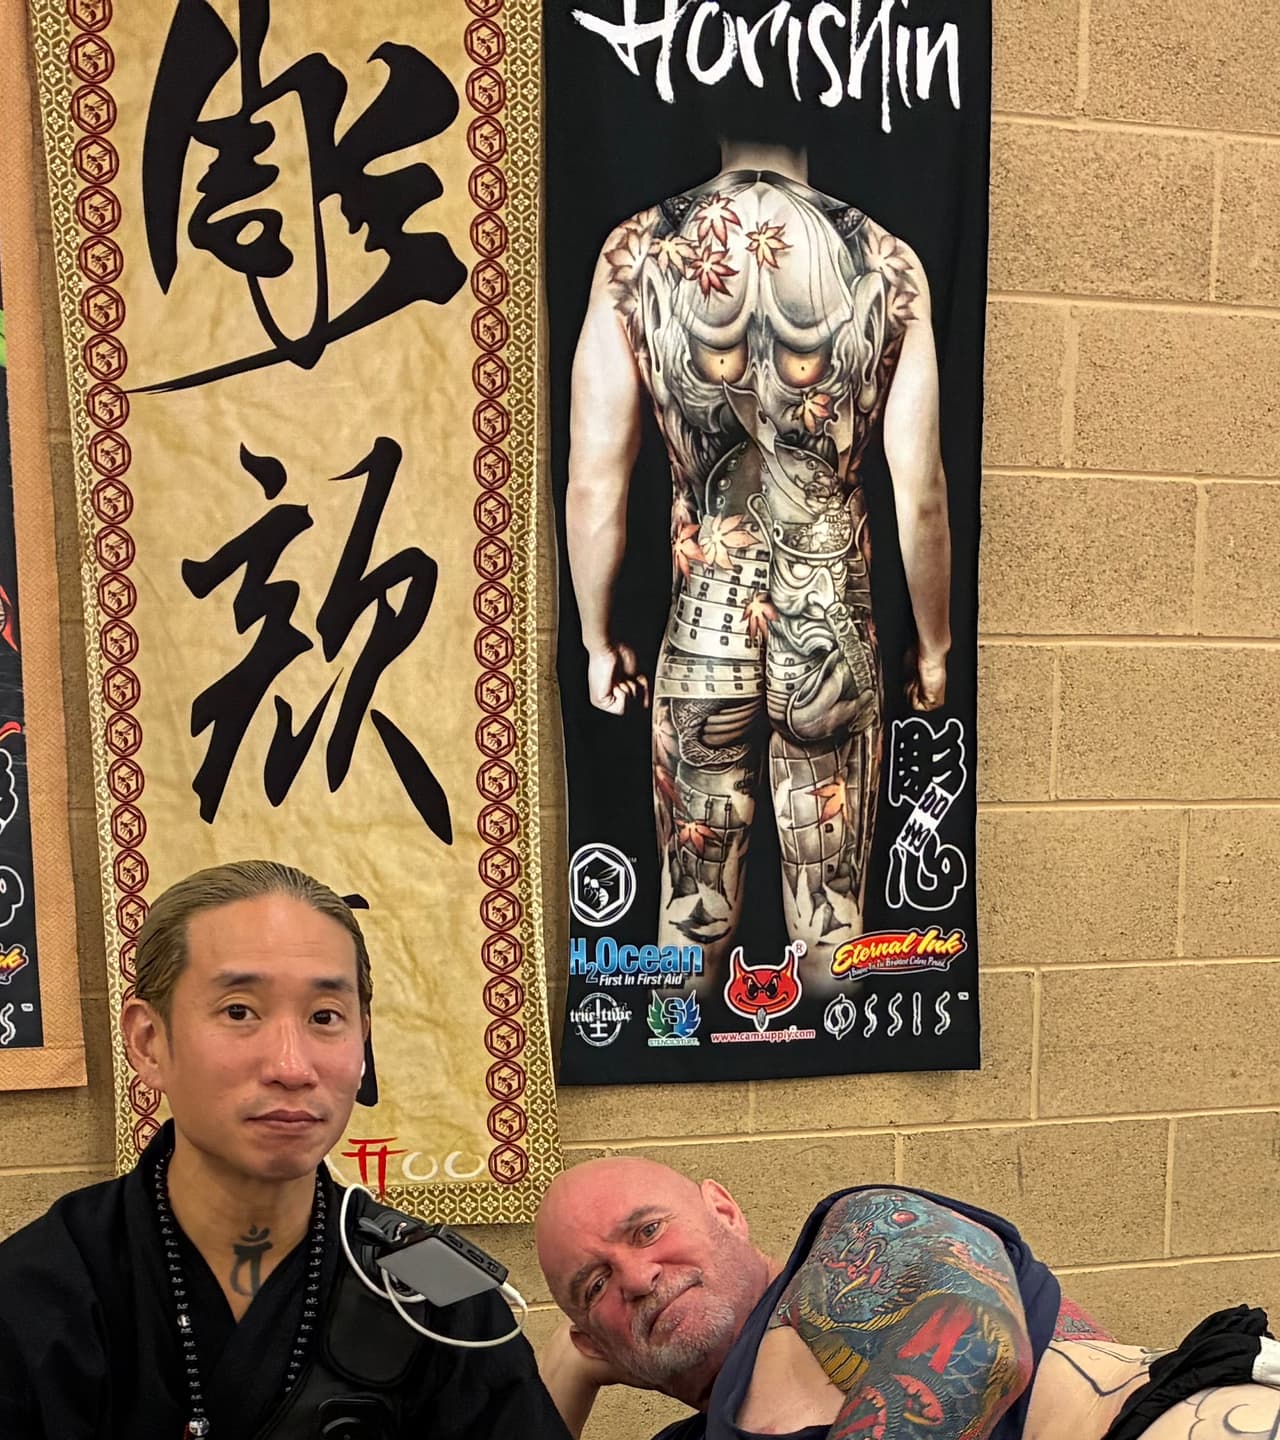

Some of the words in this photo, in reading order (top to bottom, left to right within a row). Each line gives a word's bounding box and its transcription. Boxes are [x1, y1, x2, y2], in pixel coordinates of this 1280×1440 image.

[570, 0, 960, 133] Horishin
[832, 932, 918, 974] Eternal
[917, 929, 963, 954] Ink
[599, 974, 622, 986] First
[624, 973, 634, 985] In
[637, 973, 661, 985] First
[664, 973, 683, 985] Aid
[711, 1029, 816, 1042] www.camsupply.com
